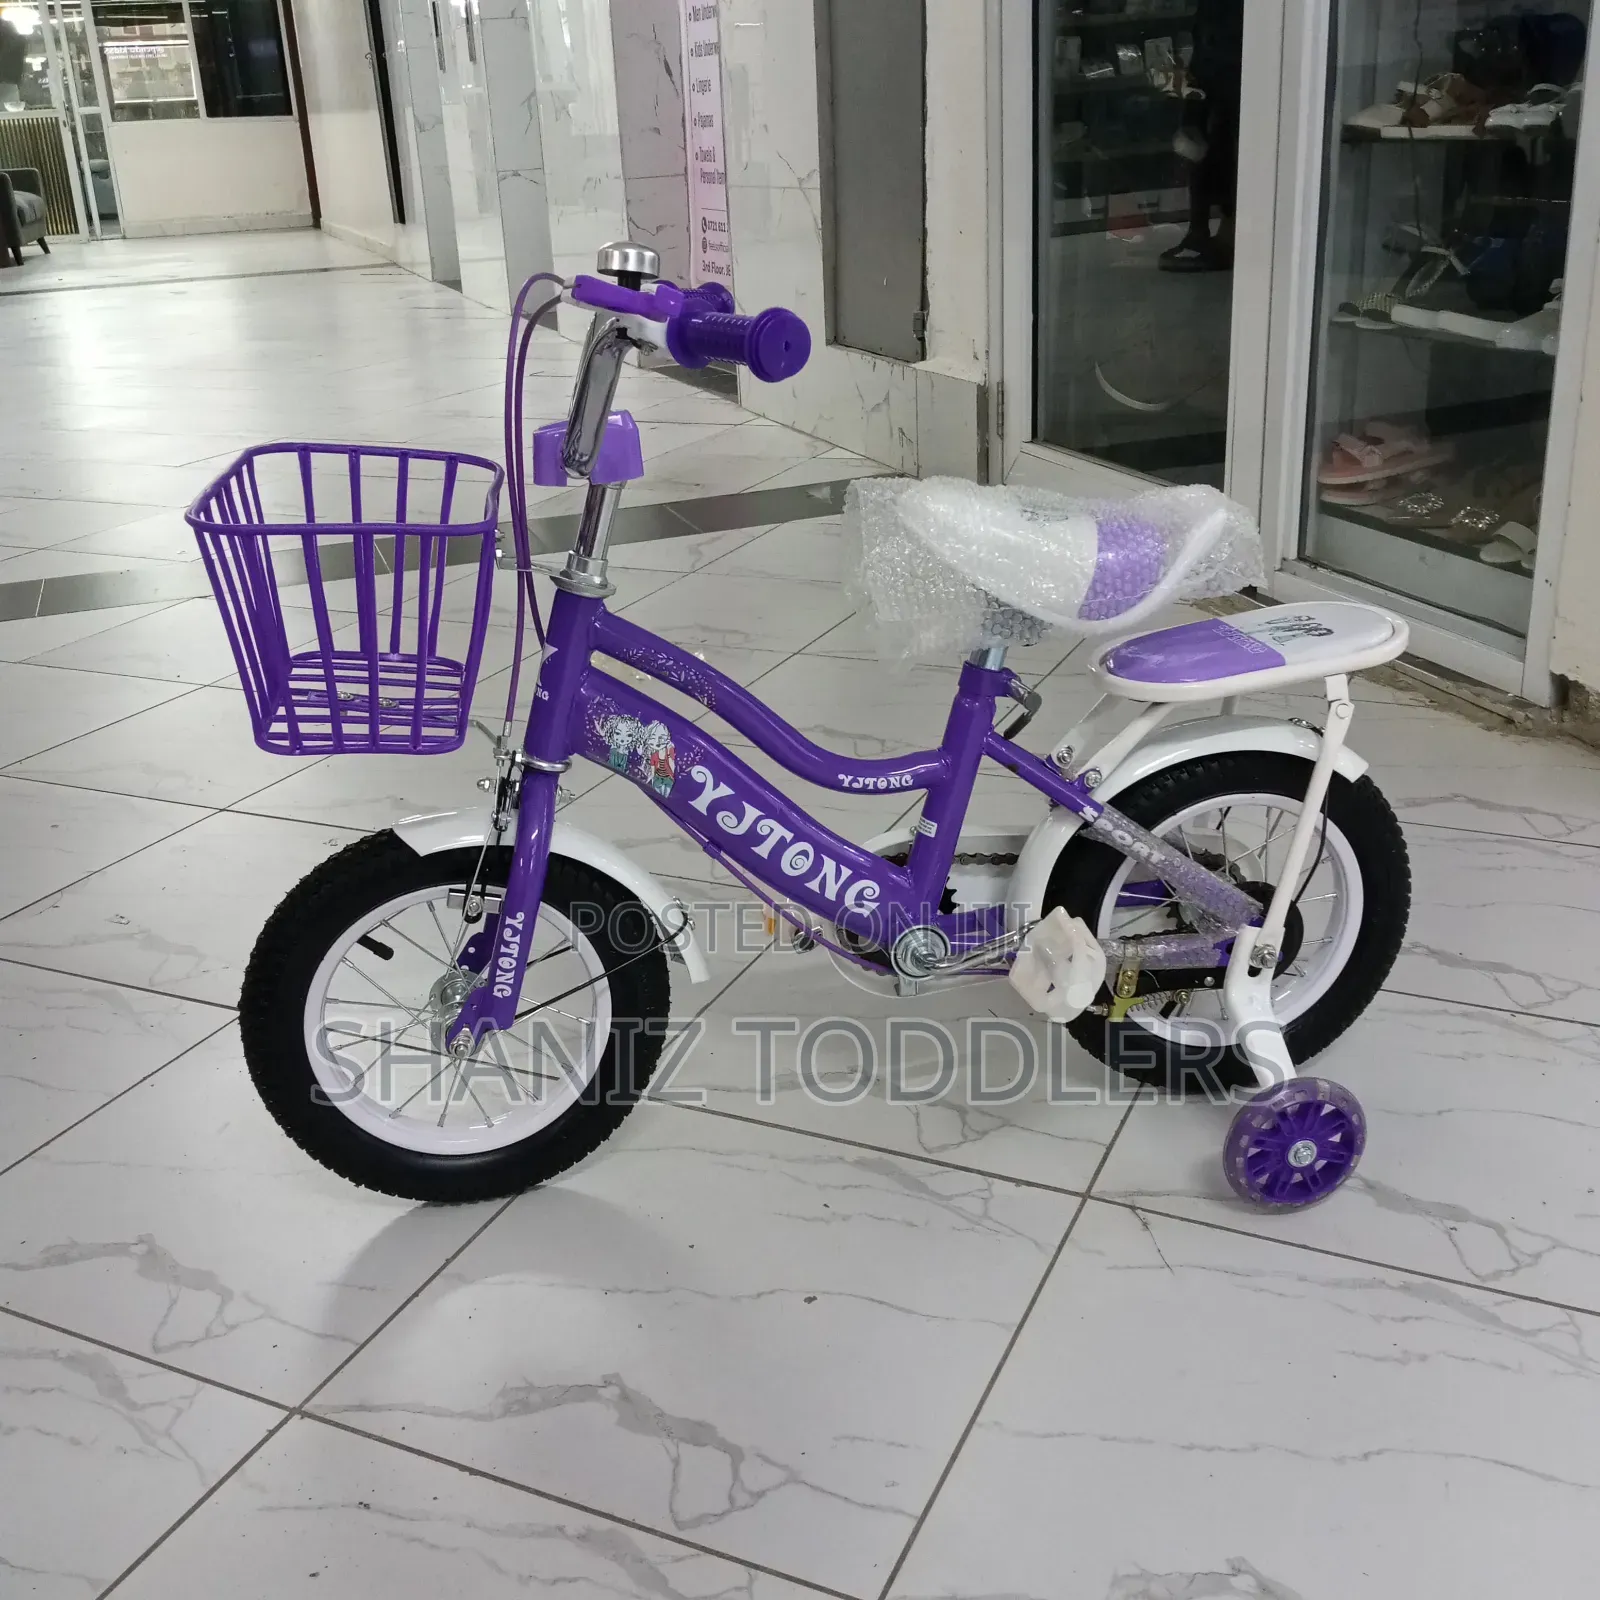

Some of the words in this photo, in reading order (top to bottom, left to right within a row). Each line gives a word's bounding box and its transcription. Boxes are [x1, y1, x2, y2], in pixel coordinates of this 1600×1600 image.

[838, 774, 914, 790] YJTONG
[688, 765, 880, 918] YJTONG
[492, 911, 525, 998] YJTONG
